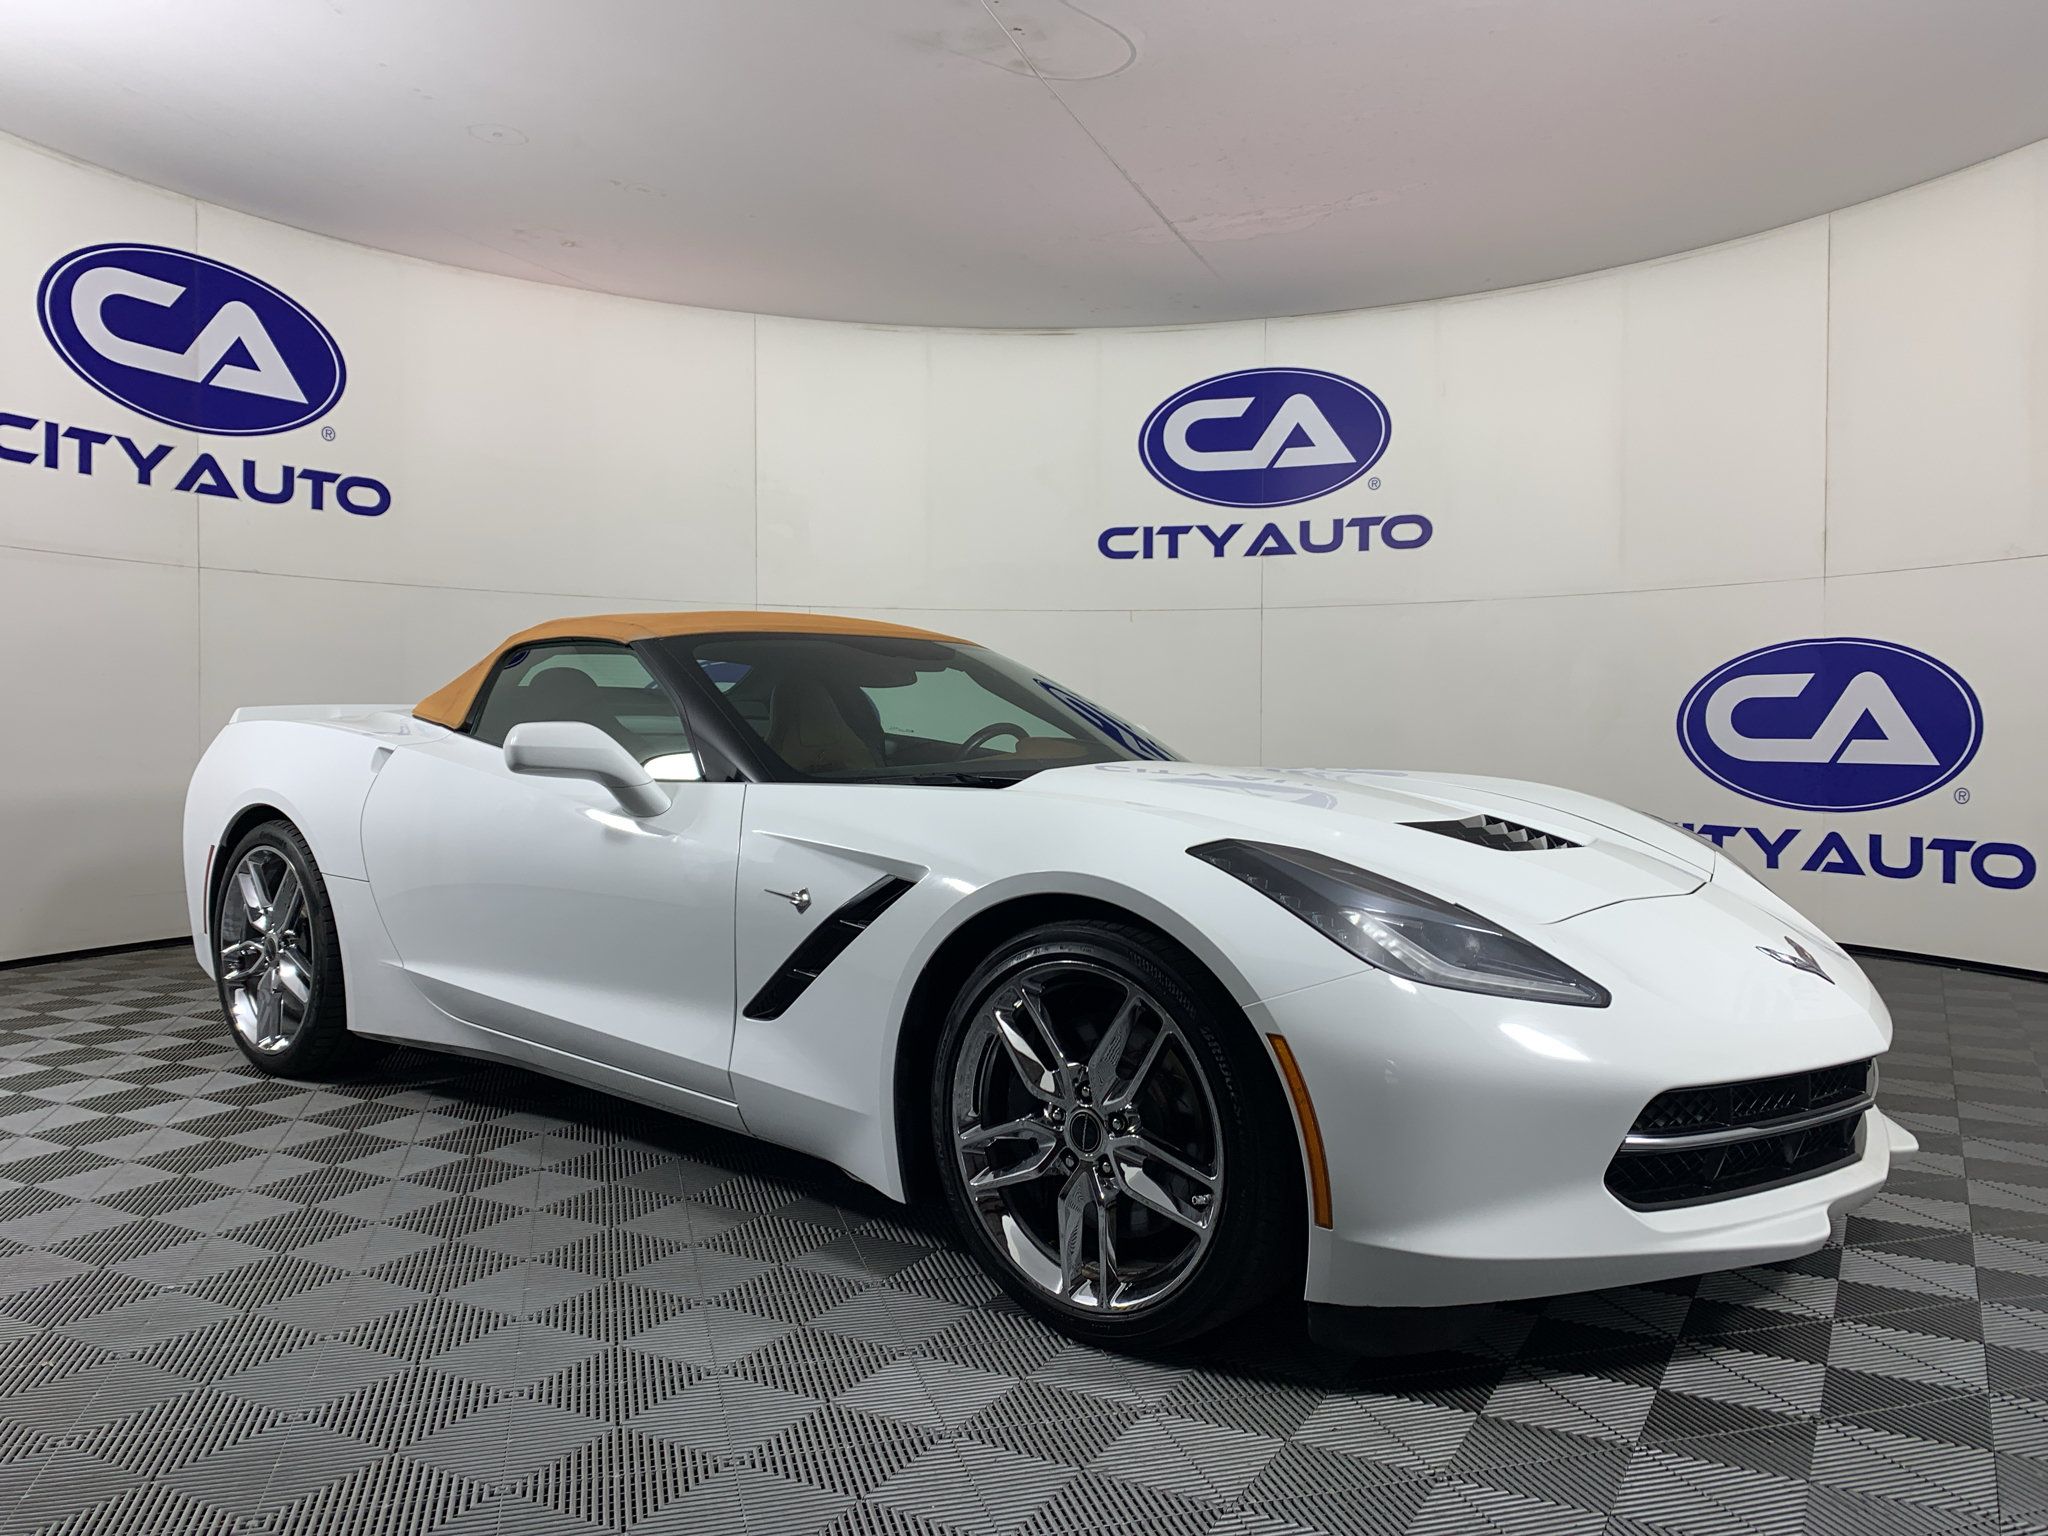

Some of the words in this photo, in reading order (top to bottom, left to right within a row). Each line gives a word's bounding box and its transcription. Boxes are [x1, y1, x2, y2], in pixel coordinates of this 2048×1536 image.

[71, 266, 309, 404] CA
[0, 412, 174, 485] CITY
[175, 453, 391, 516] AUTO
[1163, 393, 1357, 472] CA
[1098, 523, 1243, 559] CITY
[1244, 514, 1433, 556] AUTO
[1705, 671, 1940, 766] CA
[1674, 822, 1802, 869] TY
[1801, 831, 2037, 889] AUTO
